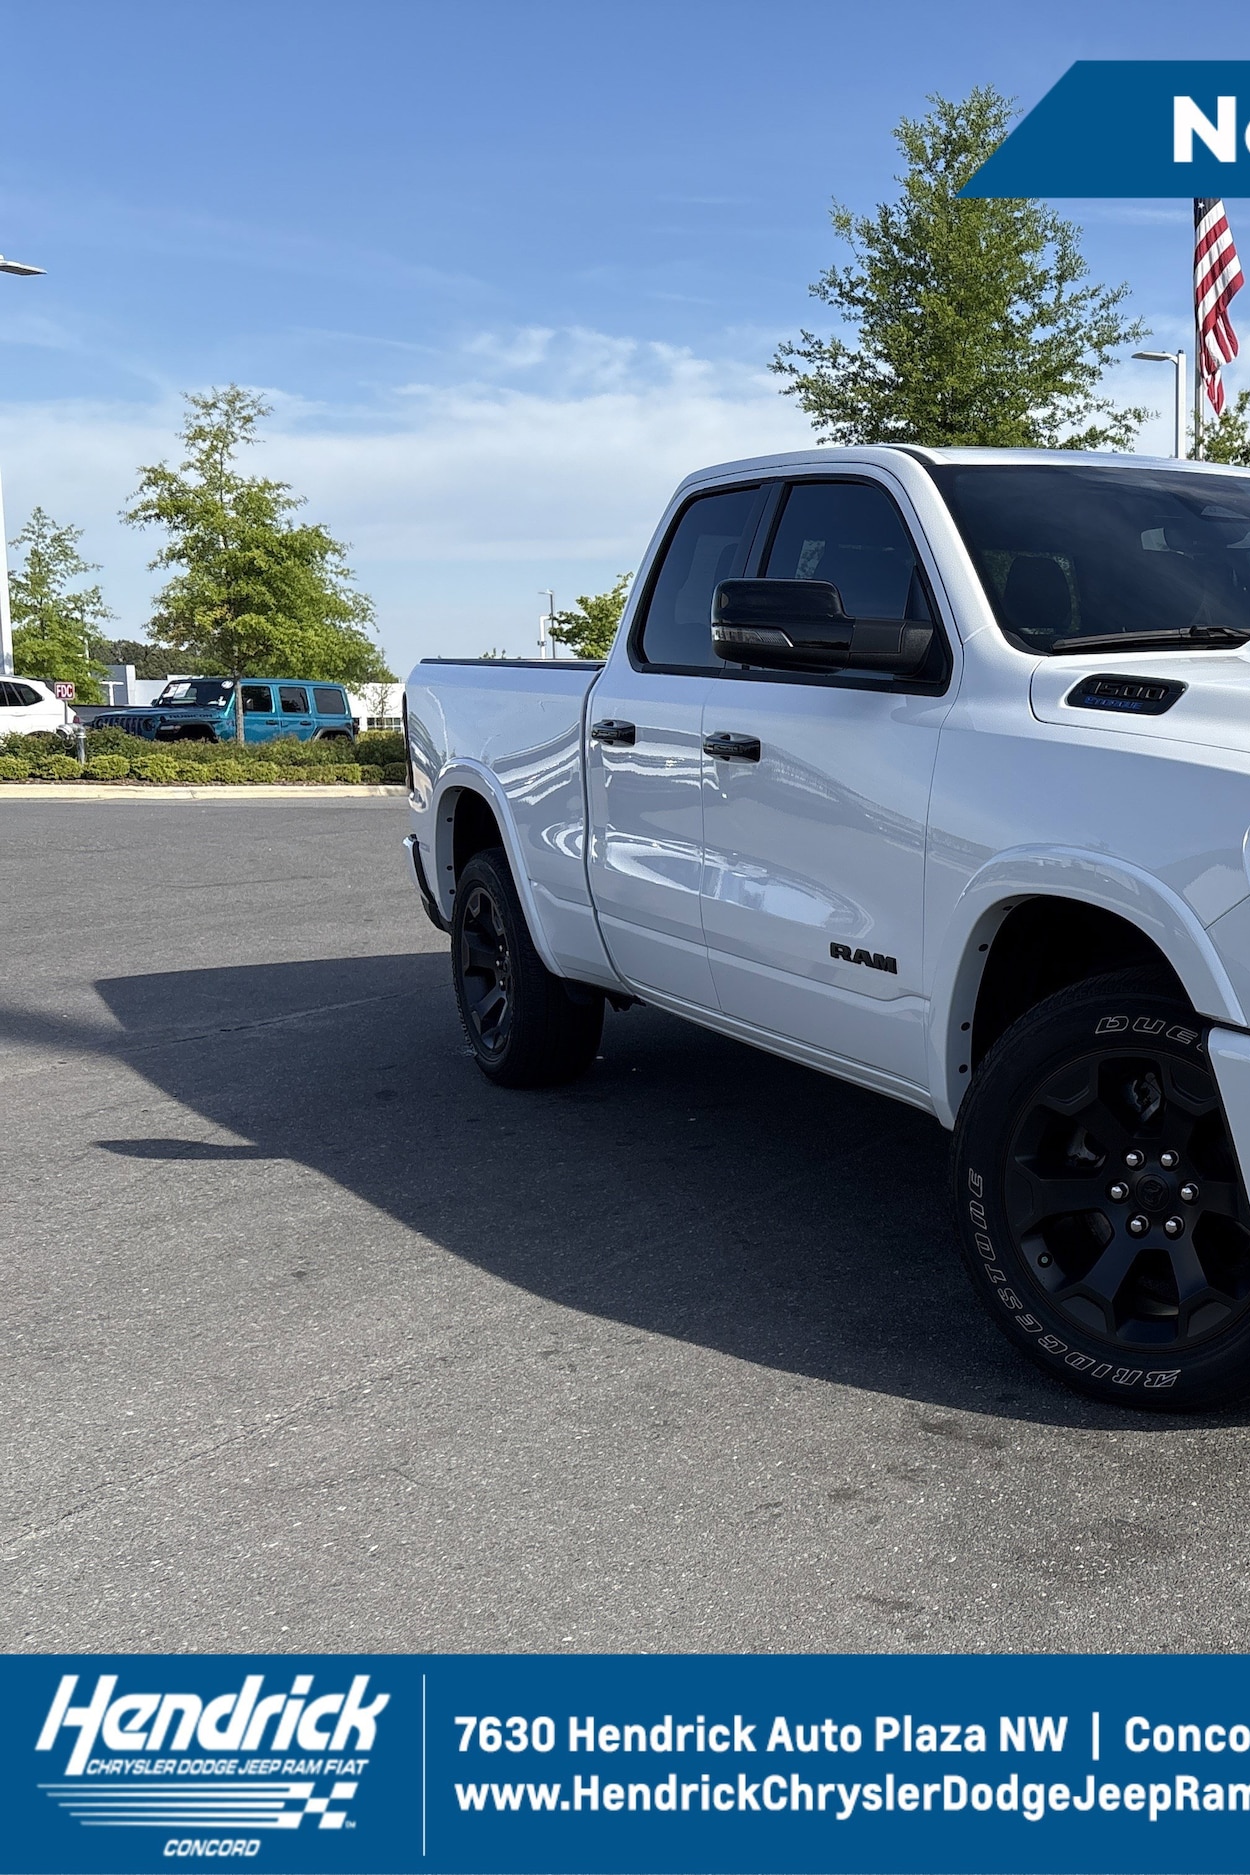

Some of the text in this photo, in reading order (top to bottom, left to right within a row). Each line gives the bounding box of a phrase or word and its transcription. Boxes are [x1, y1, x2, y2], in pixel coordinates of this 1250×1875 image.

[56, 684, 73, 698] FDC
[1089, 681, 1166, 700] 1500
[829, 941, 898, 975] RAM
[1094, 1015, 1204, 1052] DUE
[968, 1167, 1182, 1388] BRIDGESTONE
